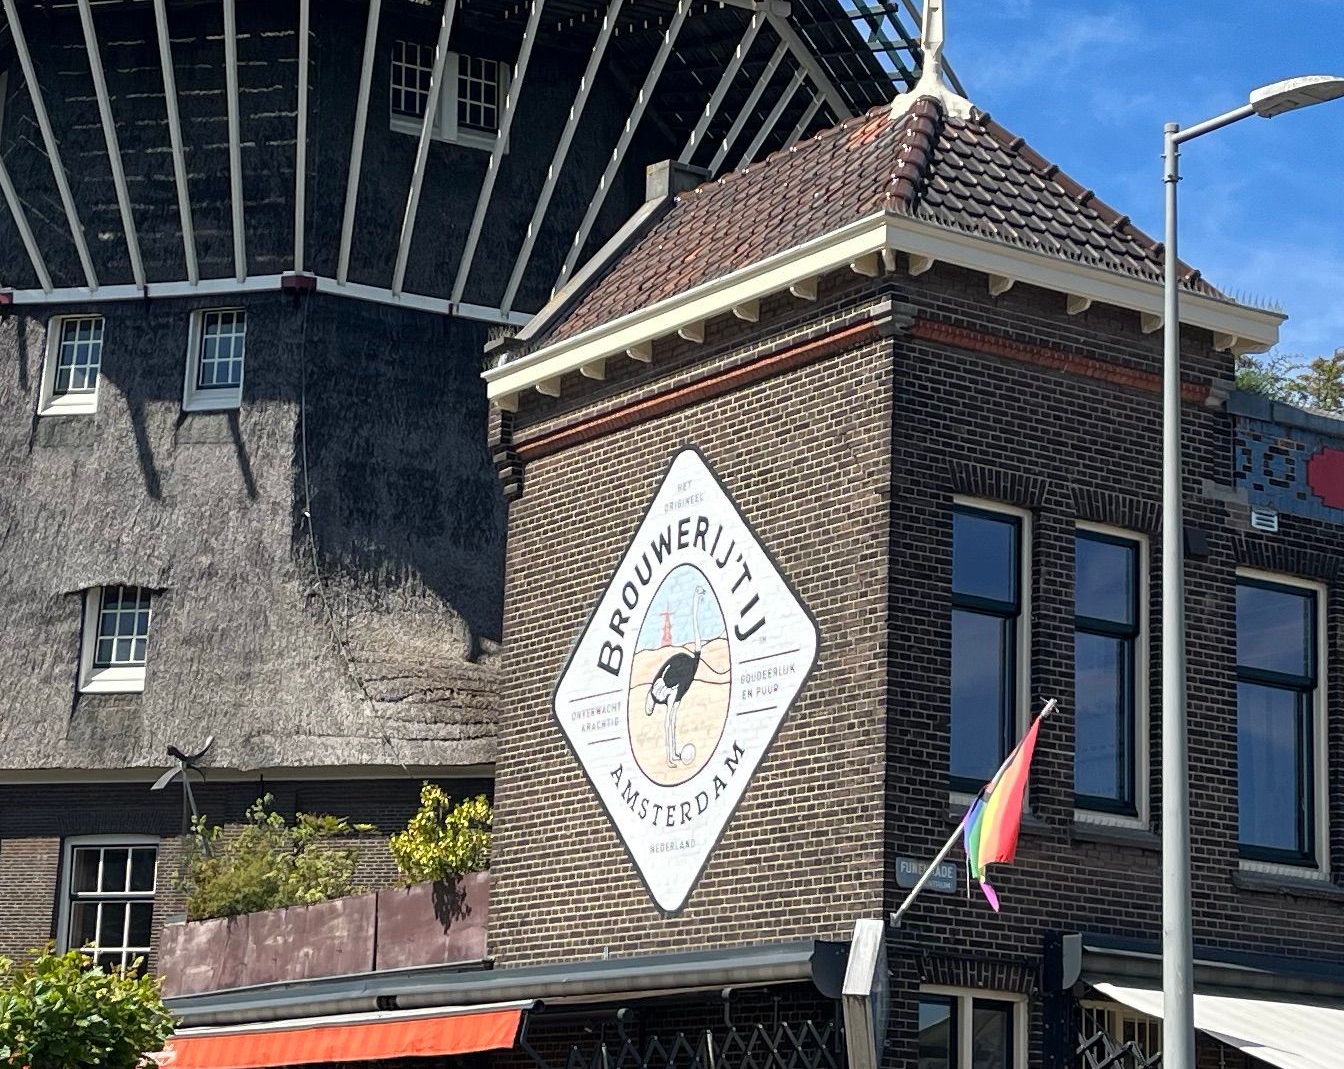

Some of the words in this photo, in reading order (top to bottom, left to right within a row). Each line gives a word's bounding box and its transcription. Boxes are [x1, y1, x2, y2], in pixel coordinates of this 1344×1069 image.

[677, 480, 693, 492] HET
[664, 492, 705, 513] ORIGINEEL
[741, 688, 753, 700] EN
[610, 739, 745, 827] AMSTERDAM
[649, 838, 696, 854] NEDERLAND
[900, 861, 954, 879] FUNEADE
